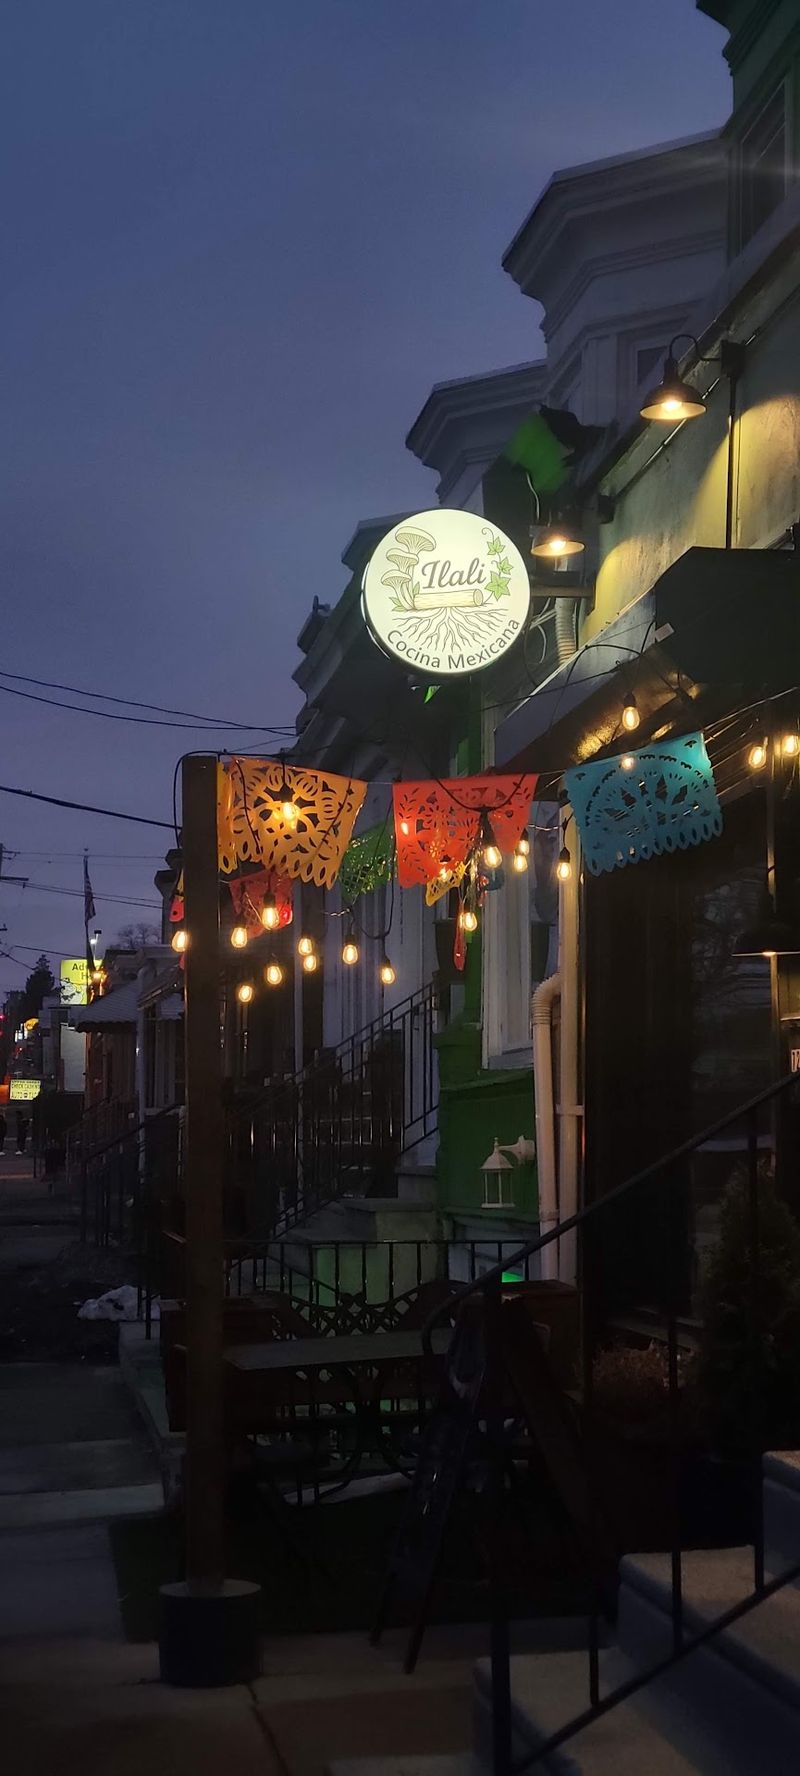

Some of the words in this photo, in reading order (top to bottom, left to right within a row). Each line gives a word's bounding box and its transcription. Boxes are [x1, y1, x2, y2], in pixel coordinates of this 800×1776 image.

[421, 558, 487, 590] Ilali
[387, 630, 441, 668] Cocina
[448, 619, 520, 669] Mexicana
